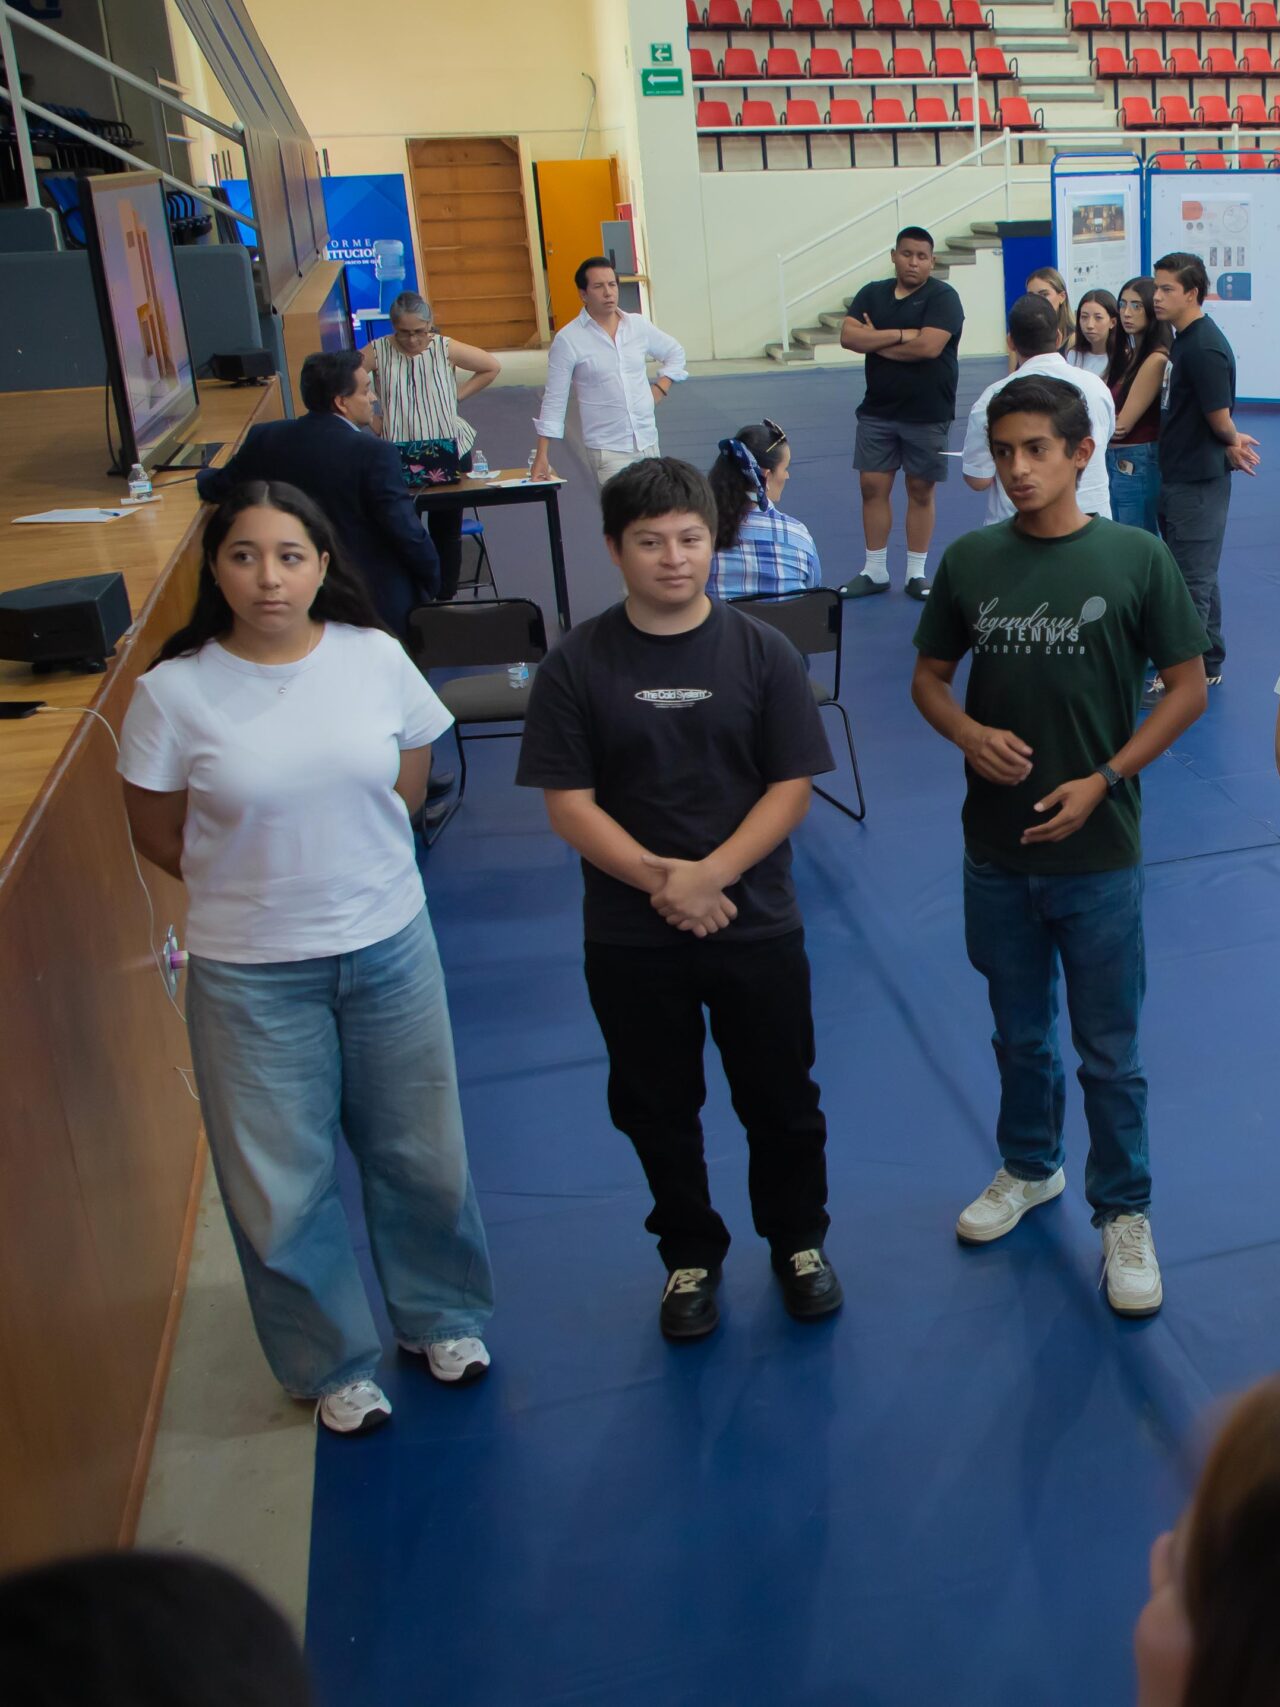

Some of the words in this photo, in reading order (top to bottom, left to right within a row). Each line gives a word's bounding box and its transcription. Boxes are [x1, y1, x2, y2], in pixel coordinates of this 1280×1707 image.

[331, 239, 371, 248] ORME
[328, 249, 376, 259] TITUCIO
[973, 597, 1074, 646] Legendary
[1005, 627, 1079, 641] TENNIS
[974, 645, 1031, 654] SPORTS
[1045, 646, 1085, 654] CLUB
